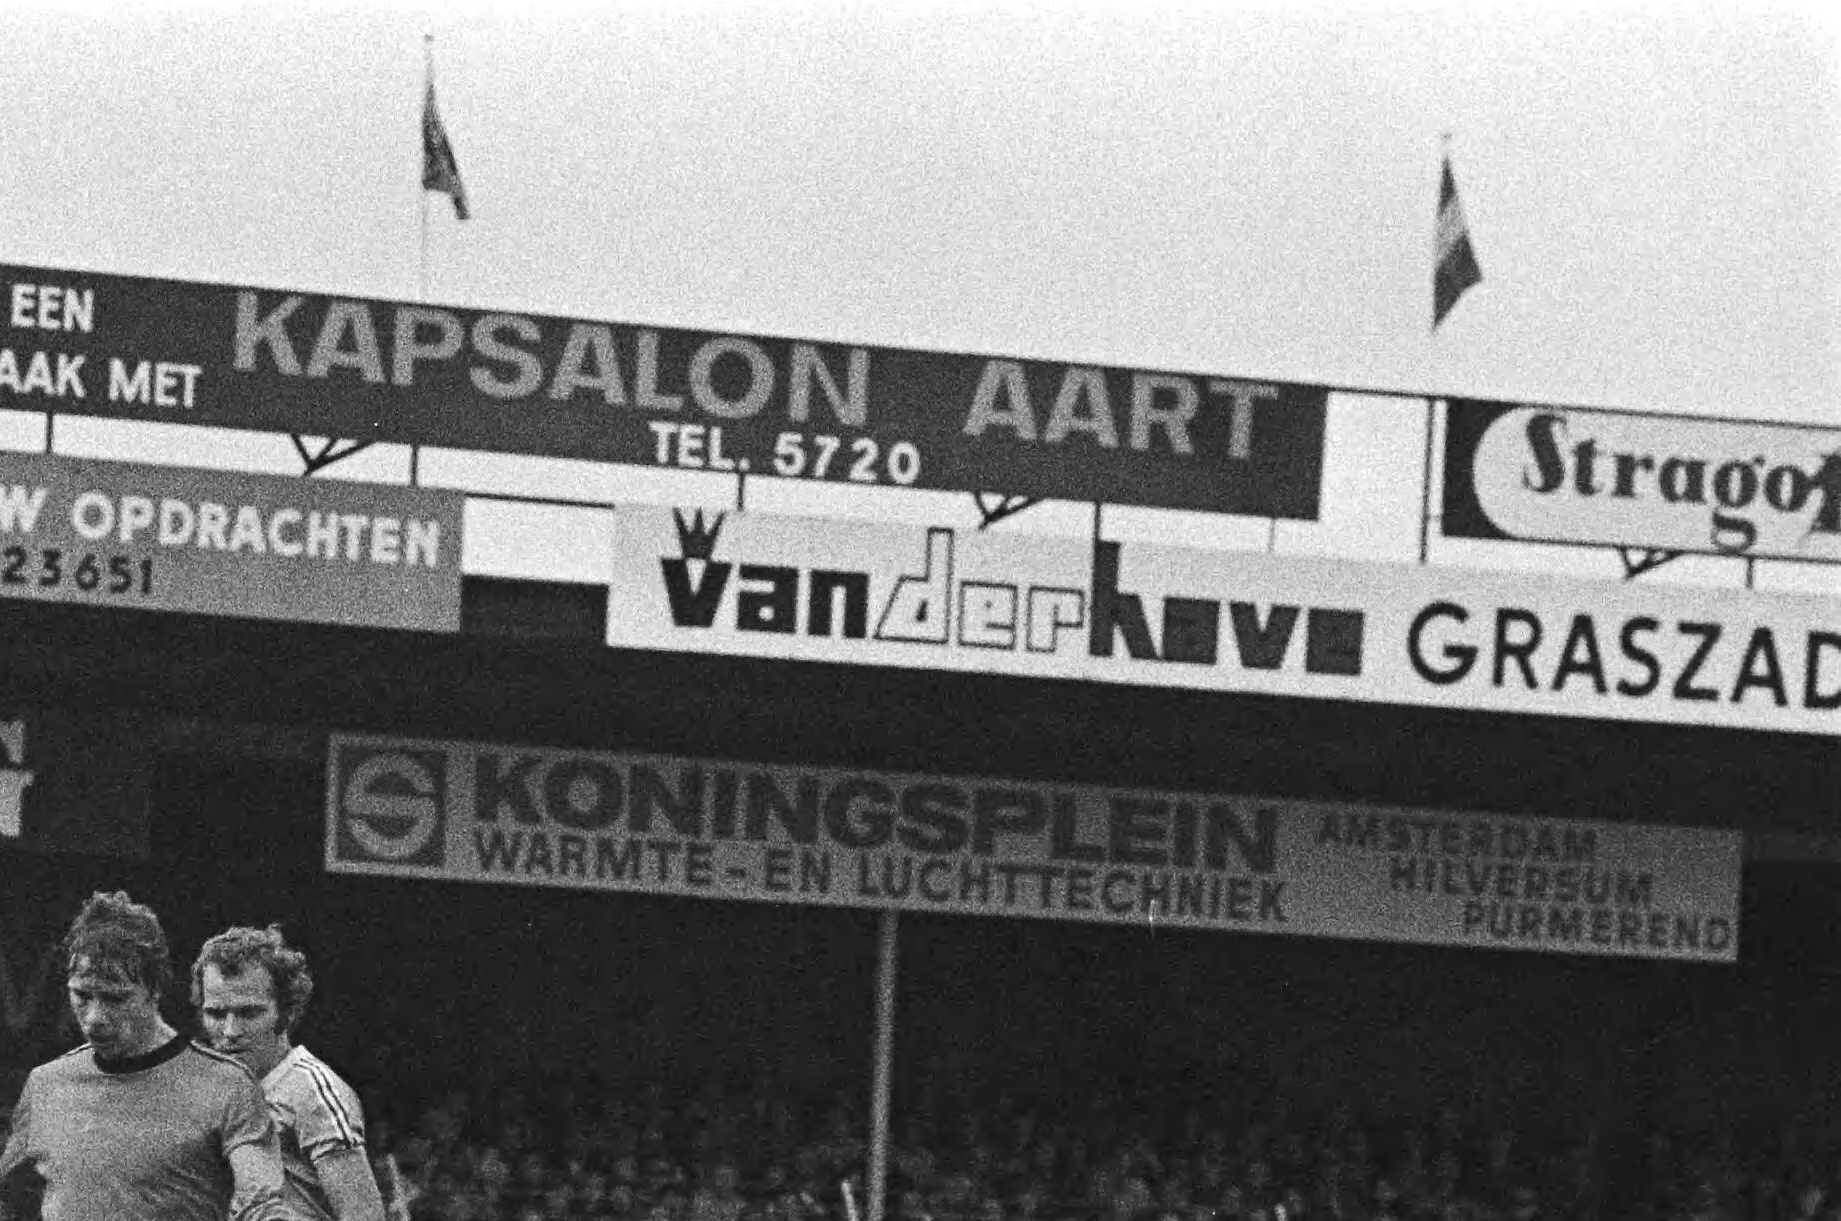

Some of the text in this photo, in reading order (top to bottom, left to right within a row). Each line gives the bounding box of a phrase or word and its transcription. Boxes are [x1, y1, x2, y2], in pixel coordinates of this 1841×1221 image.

[11, 283, 94, 332] EEN
[108, 358, 202, 408] MET
[233, 292, 1278, 459] KAPSALON AART
[650, 421, 922, 484] TEL. 5720
[70, 492, 440, 567] OPDRACHTEN
[2, 546, 155, 595] 23651
[1406, 600, 1841, 710] GRASZAD
[473, 752, 1279, 874] KONINGSPLEIN
[1316, 812, 1598, 862] AMSTERDAM
[857, 855, 1289, 923] LUCHTTECHNIEK
[1389, 856, 1654, 908] HILVERSUM
[1462, 902, 1732, 953] PURMEREND
